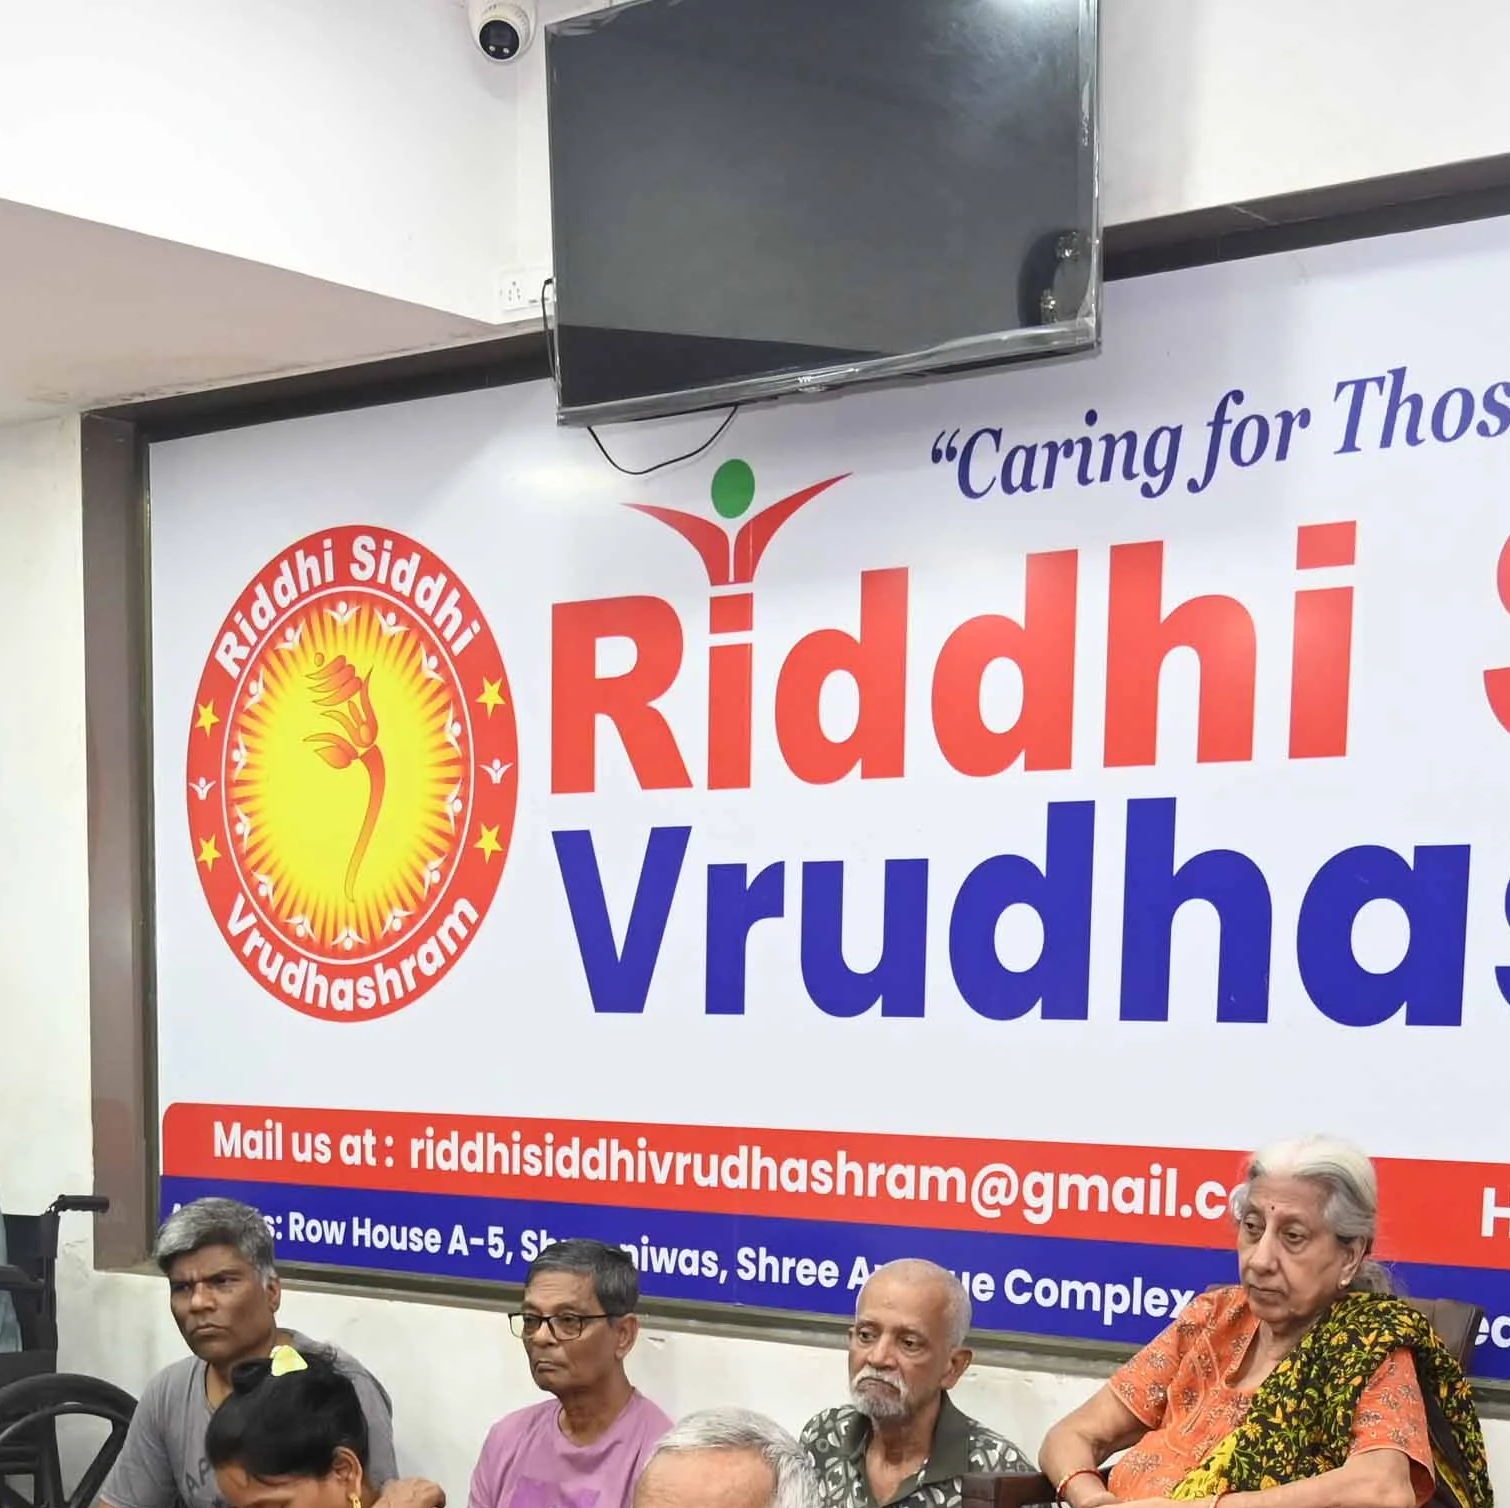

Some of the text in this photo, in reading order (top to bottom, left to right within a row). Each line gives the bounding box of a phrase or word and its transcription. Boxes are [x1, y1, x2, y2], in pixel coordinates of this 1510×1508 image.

[932, 410, 1182, 498] “Caring
[1188, 390, 1311, 493] for
[214, 535, 481, 680] Riddhi Siddhi
[552, 523, 1355, 793] Riddhi
[227, 893, 479, 1011] Vrudhashram
[214, 1120, 283, 1161] Mail
[292, 1133, 332, 1164] us
[410, 1126, 1243, 1225] riddhisiddhivrudhashram@gmail.c
[288, 1211, 347, 1246] Row
[352, 1216, 442, 1254] House
[447, 1225, 514, 1265] A-5,
[737, 1247, 839, 1289] Shree
[1004, 1269, 1196, 1326] Complex
